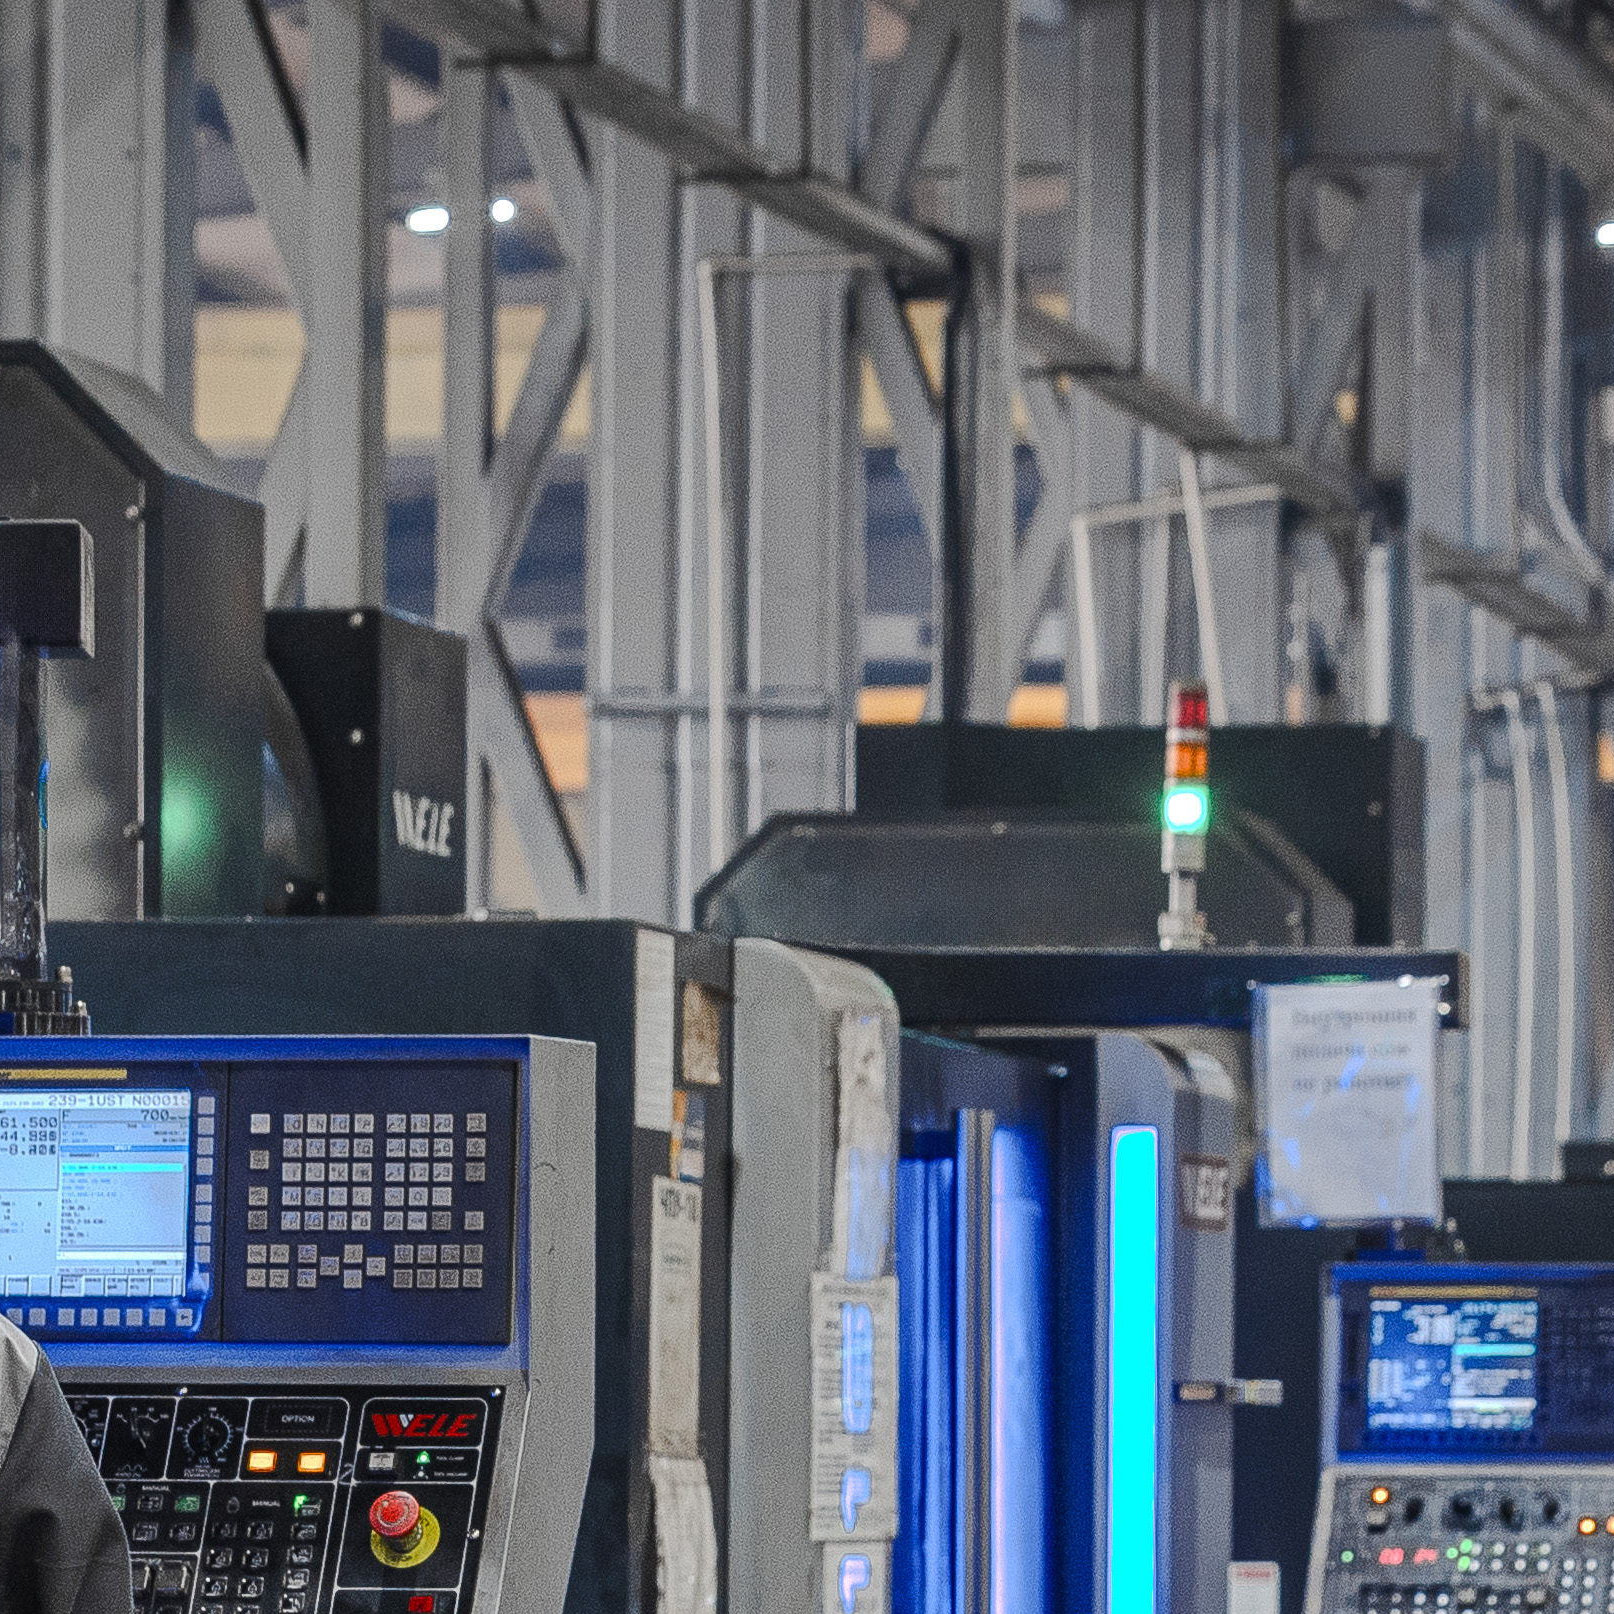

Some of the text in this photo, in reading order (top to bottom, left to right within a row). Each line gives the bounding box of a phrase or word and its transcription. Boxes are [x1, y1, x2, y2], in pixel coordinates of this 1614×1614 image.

[140, 1109, 169, 1121] 700
[0, 1116, 58, 1128] 61.500
[281, 1414, 316, 1423] OPTION
[372, 1413, 477, 1437] WELE
